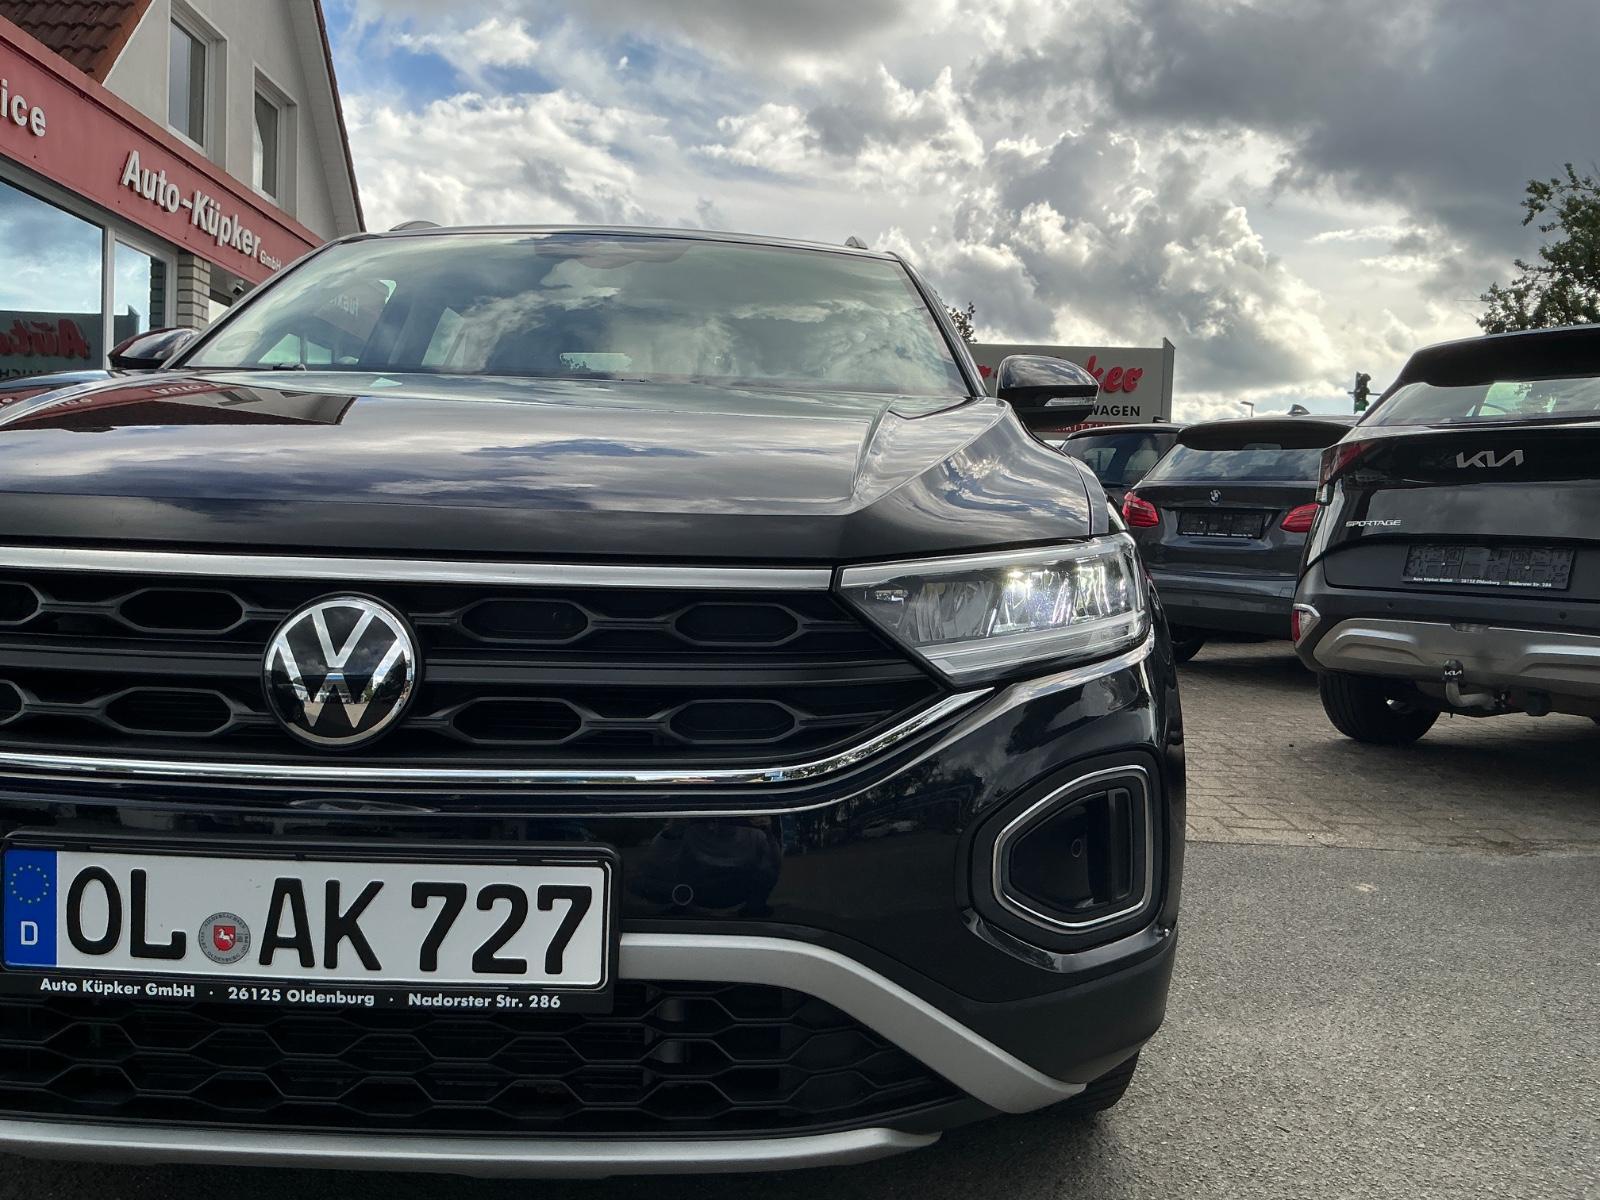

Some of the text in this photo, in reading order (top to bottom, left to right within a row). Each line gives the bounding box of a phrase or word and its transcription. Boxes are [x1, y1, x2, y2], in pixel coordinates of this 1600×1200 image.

[1, 78, 46, 137] ice
[121, 150, 282, 271] Auto-Küpker GmbH
[1086, 355, 1144, 393] ker
[1456, 449, 1524, 468] KIA
[1345, 519, 1402, 528] SPORTAGE
[20, 920, 39, 947] D
[65, 865, 593, 975] OL AK 727
[39, 978, 561, 1008] Auto Küpker GmbH 26125 Oldenburg Nadorster Str. 286
